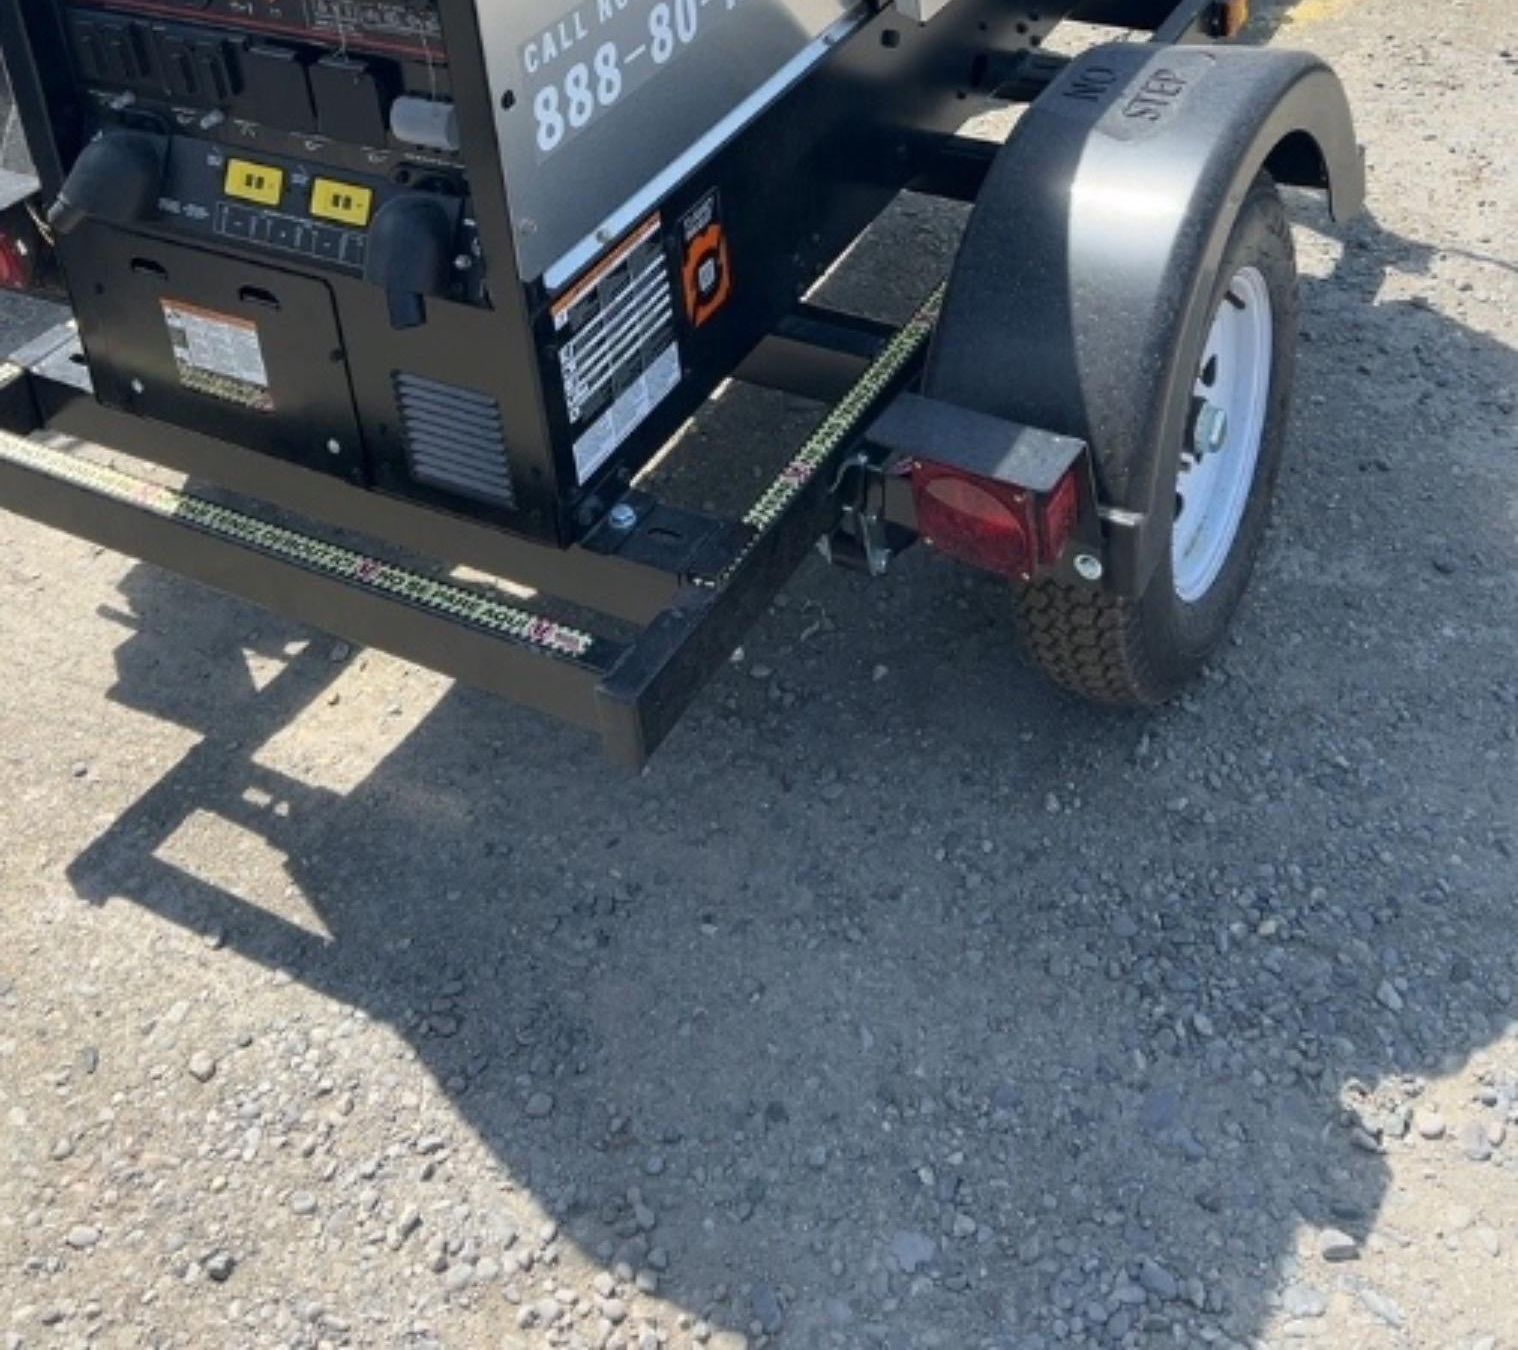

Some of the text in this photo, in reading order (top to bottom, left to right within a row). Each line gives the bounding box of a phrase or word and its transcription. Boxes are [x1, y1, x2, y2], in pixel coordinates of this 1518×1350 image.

[523, 19, 588, 74] CALL
[1062, 66, 1117, 102] NO
[1122, 67, 1188, 122] STEP
